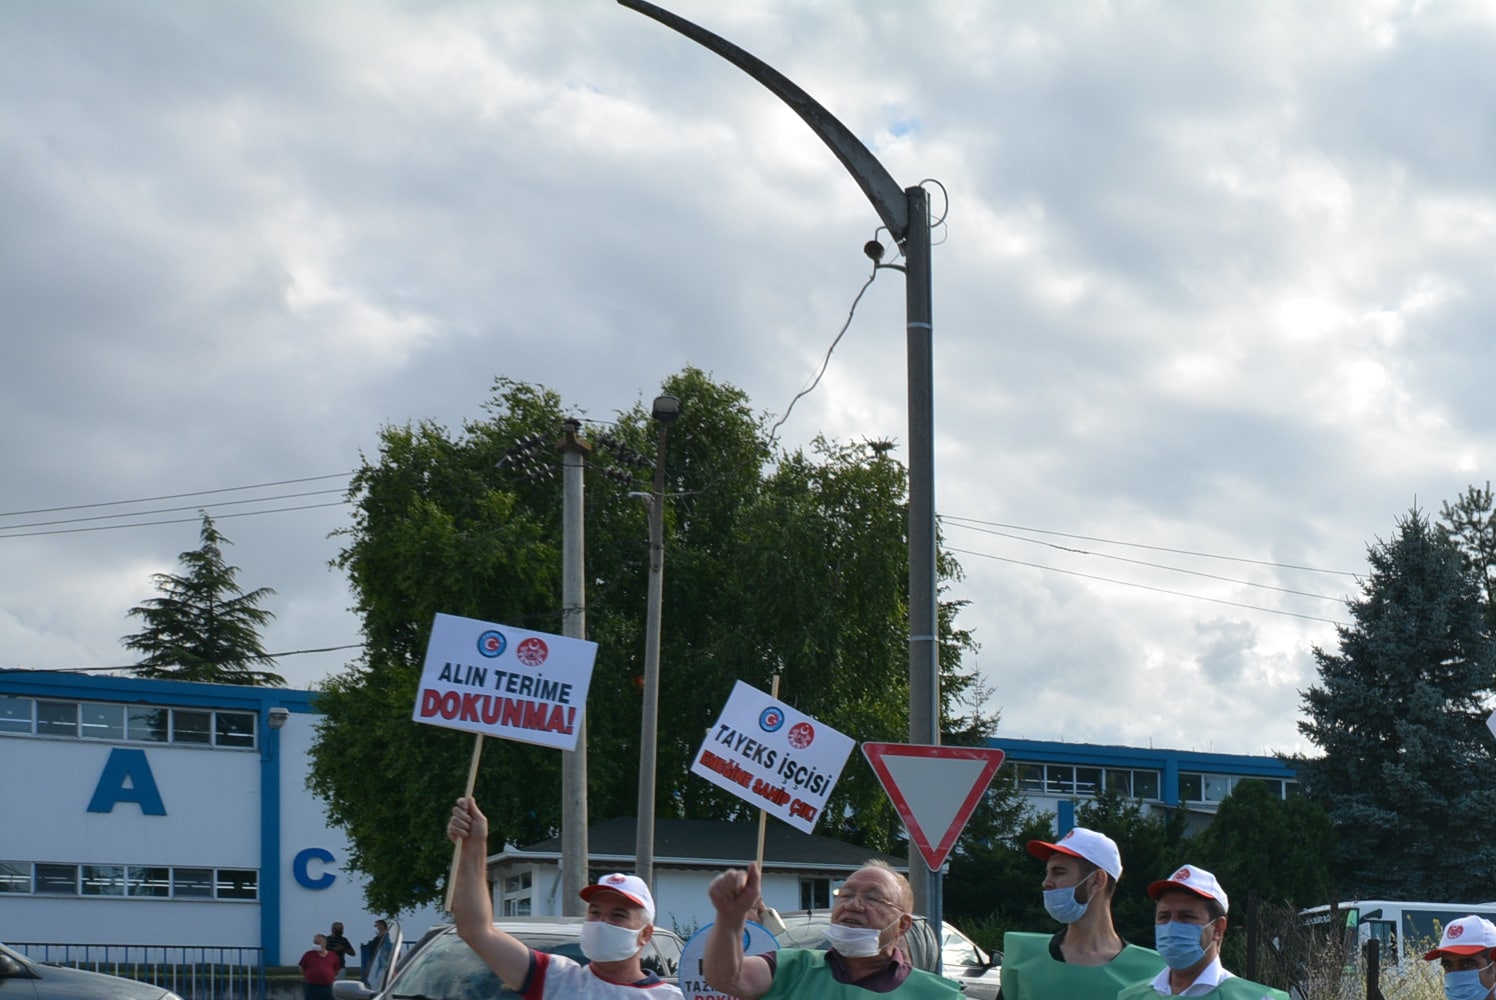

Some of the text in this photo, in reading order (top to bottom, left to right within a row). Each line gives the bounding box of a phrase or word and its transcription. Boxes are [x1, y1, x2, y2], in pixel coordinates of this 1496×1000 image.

[438, 662, 573, 704] ALIN TERİME
[420, 688, 577, 735] DOKUNMA!
[86, 747, 167, 816] A
[715, 724, 833, 797] TAYEKS İŞÇİSİ
[292, 847, 337, 891] C
